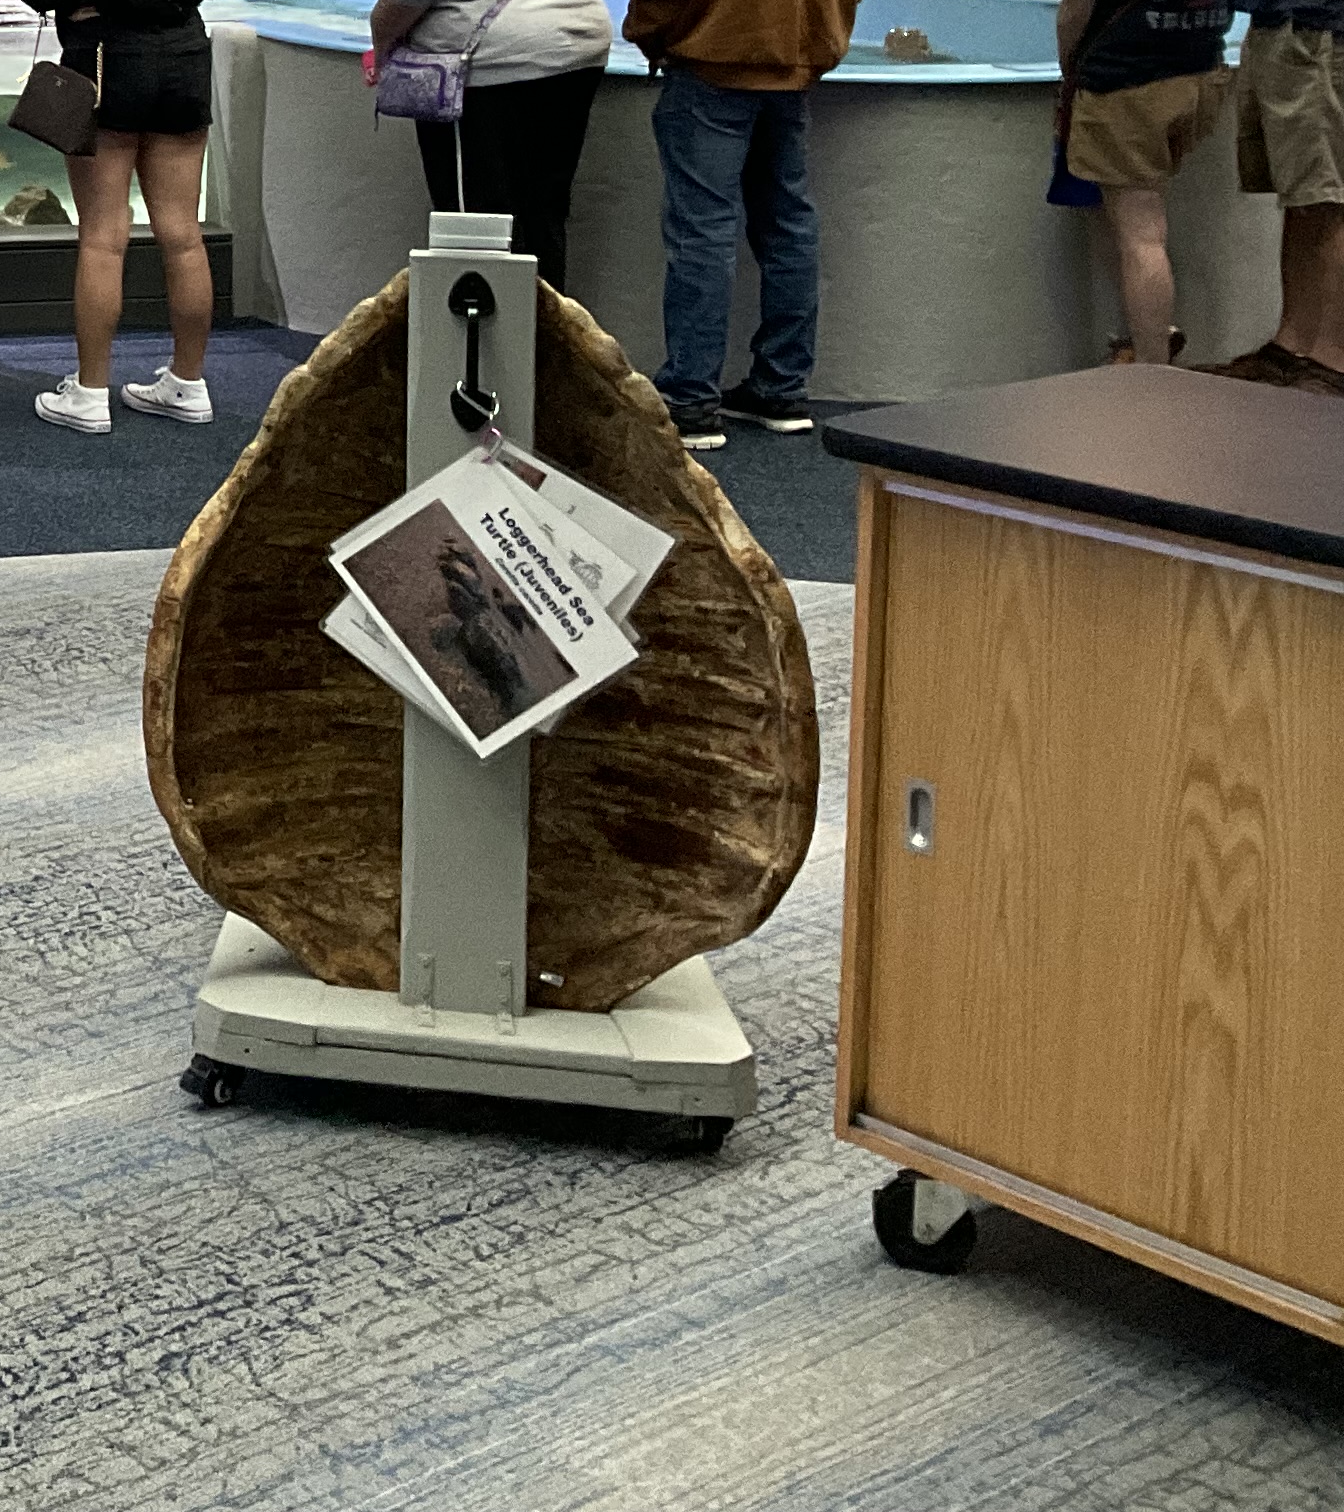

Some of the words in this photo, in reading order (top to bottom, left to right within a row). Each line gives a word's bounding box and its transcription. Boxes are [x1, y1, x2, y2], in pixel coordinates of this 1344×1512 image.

[480, 512, 517, 560] Turtle
[514, 561, 584, 642] (Juveniles)
[498, 507, 573, 595] Loggerhead
[569, 596, 594, 627] Sea
